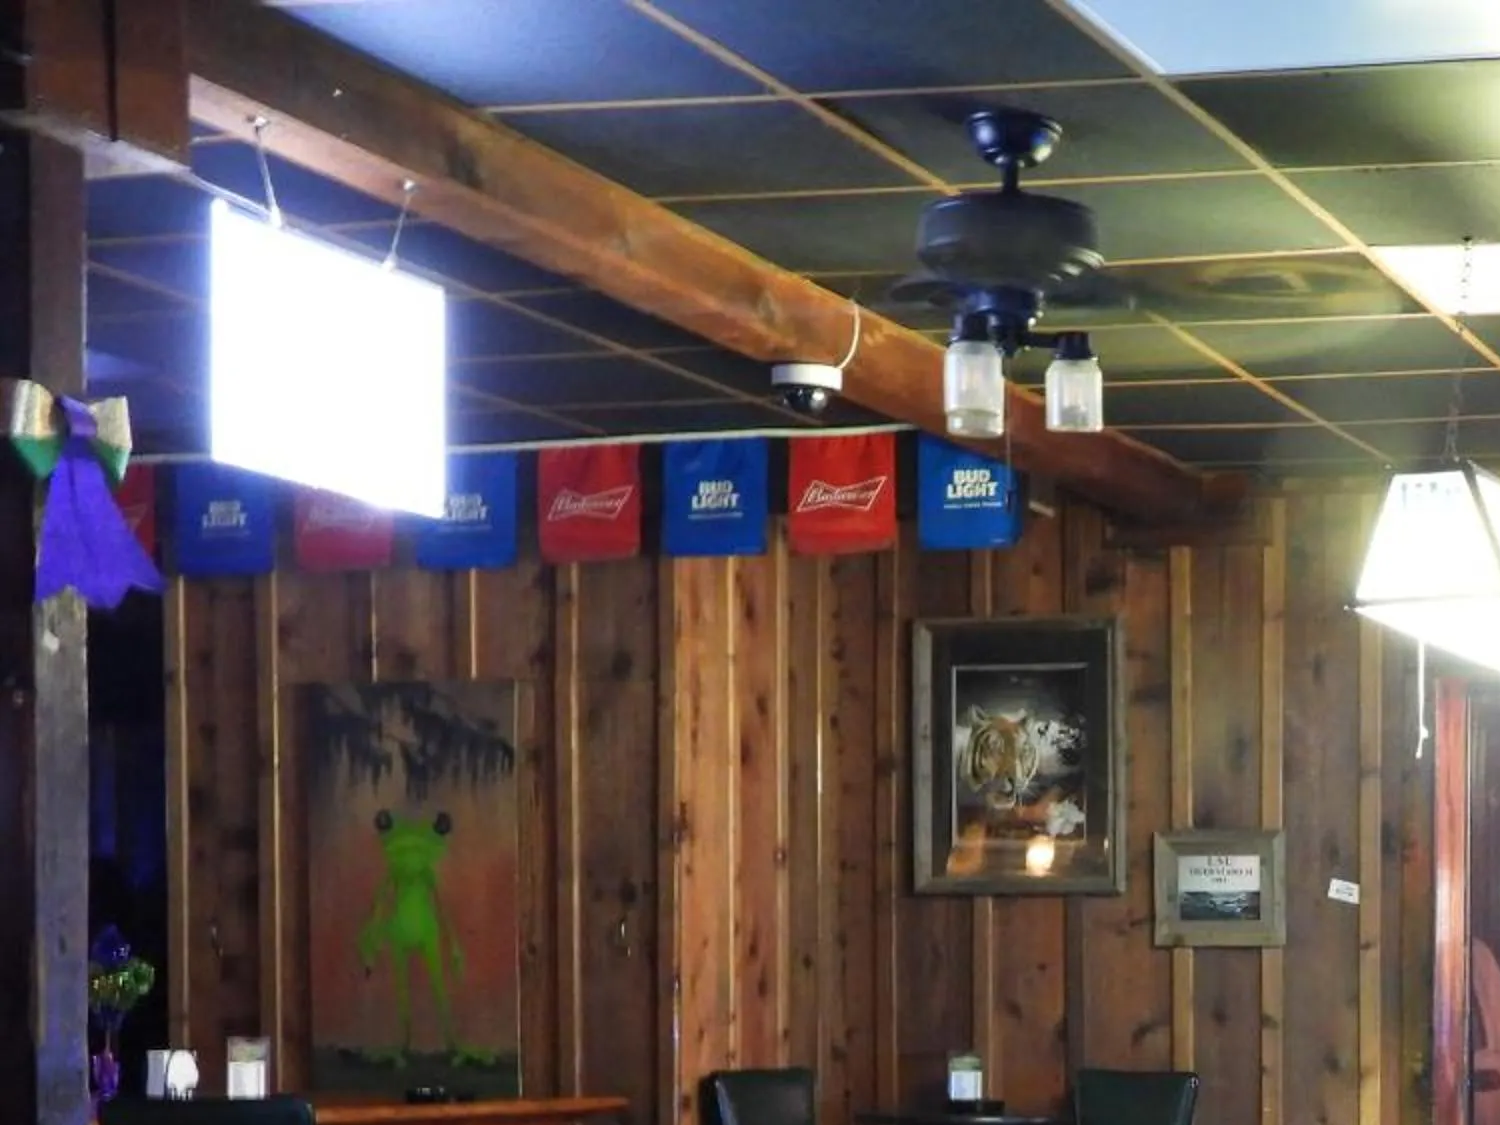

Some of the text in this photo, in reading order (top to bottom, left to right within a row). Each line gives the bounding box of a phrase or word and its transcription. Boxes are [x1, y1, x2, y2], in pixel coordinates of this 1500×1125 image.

[953, 469, 991, 484] BUD
[698, 480, 733, 495] BUD
[805, 486, 879, 503] Budweiser
[946, 482, 998, 499] LIGHT
[691, 493, 740, 509] LIGHT
